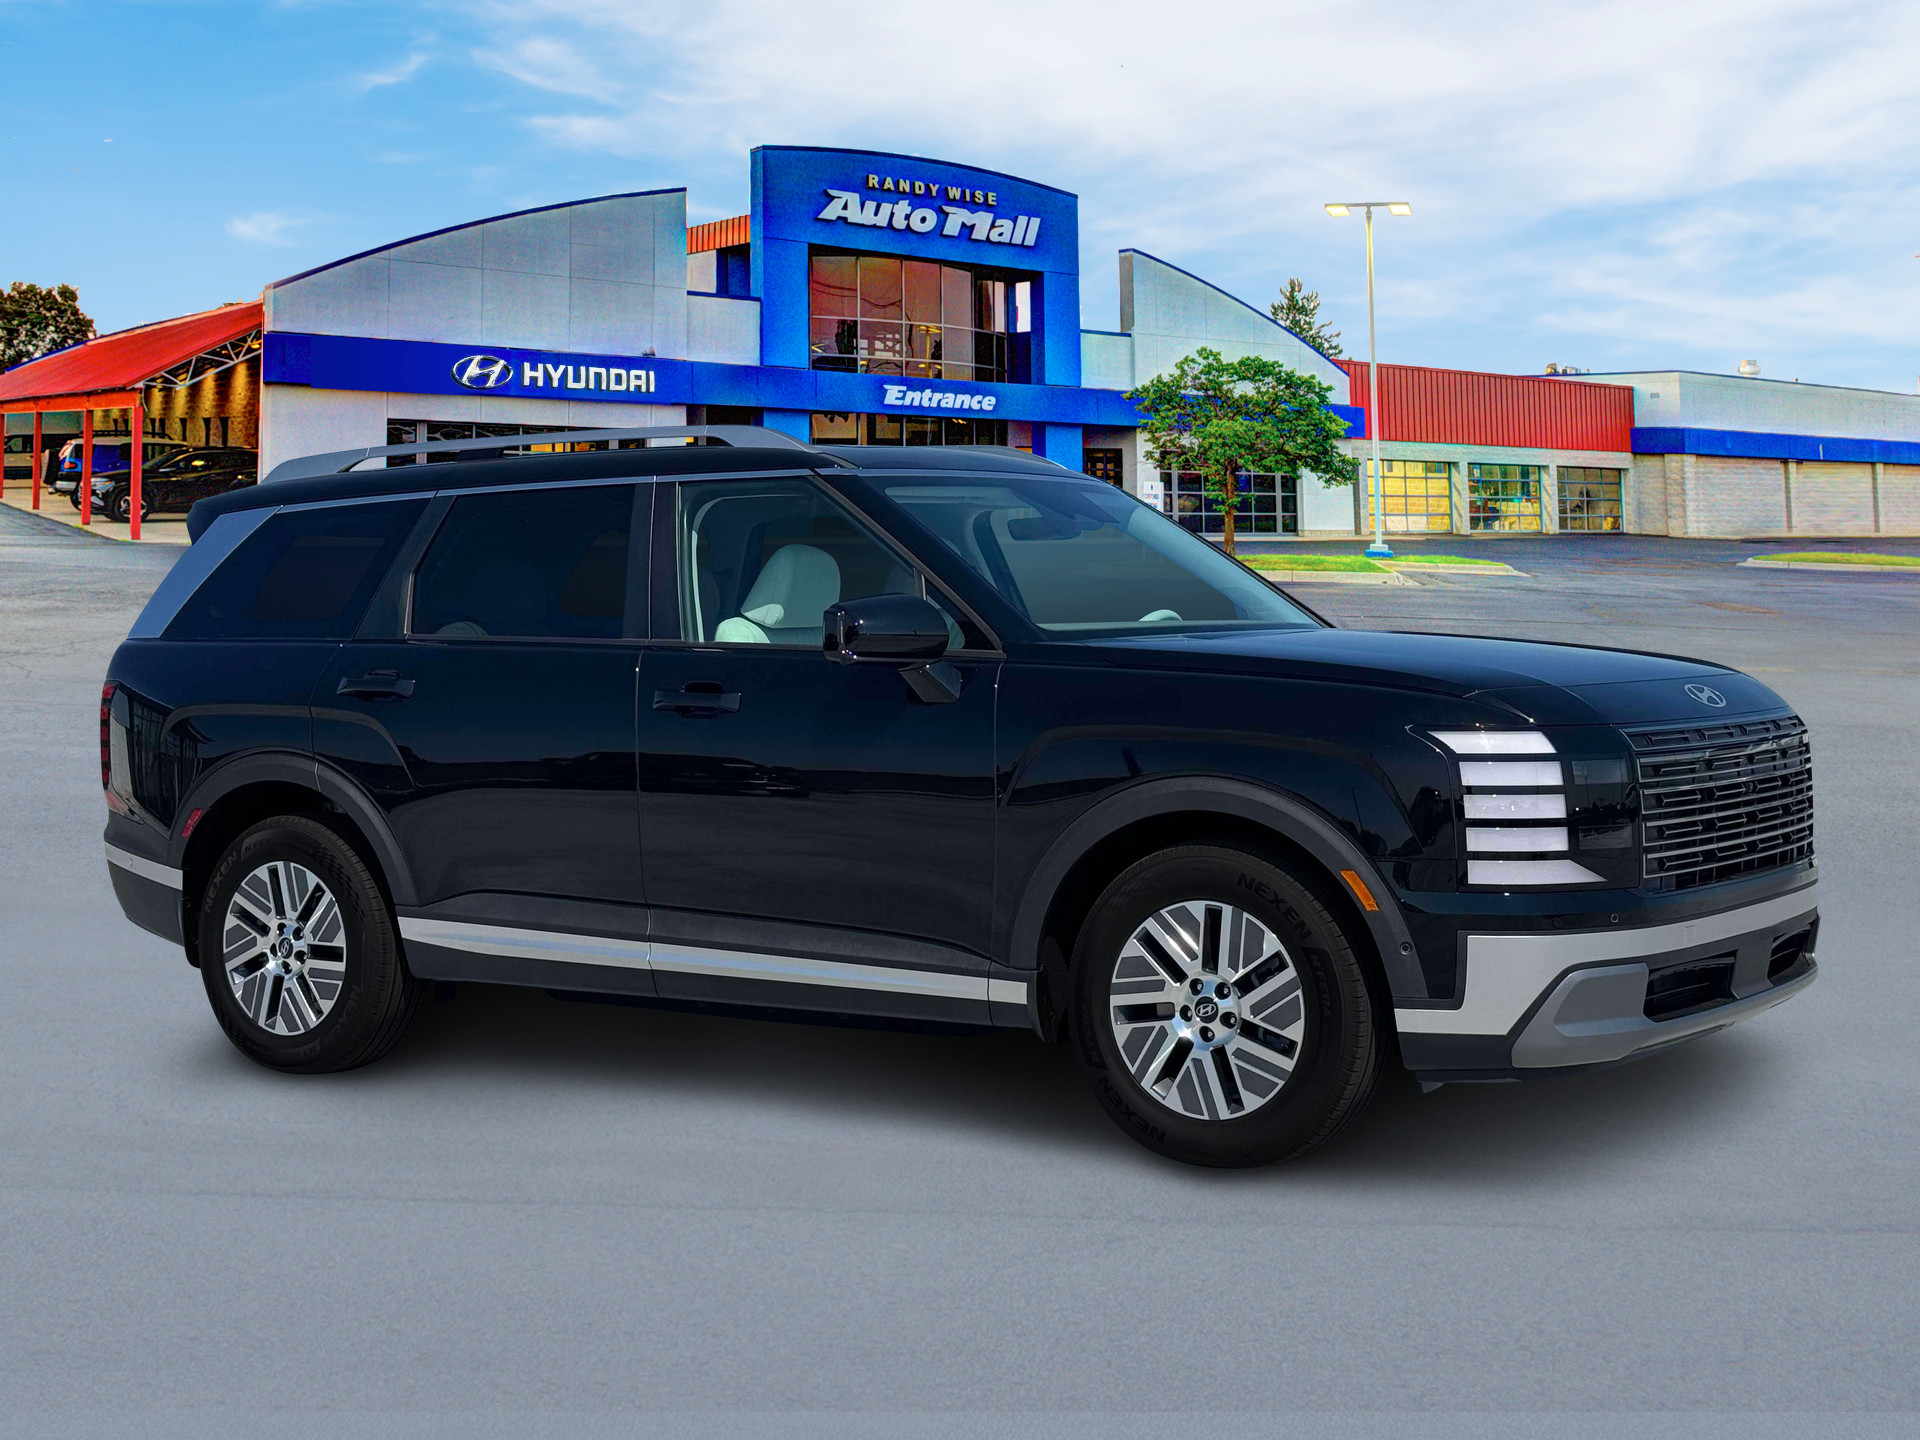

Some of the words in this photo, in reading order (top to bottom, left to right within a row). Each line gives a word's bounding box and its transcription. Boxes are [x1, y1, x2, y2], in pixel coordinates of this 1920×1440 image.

[817, 188, 937, 233] Auto
[941, 205, 1041, 247] Mall
[867, 174, 939, 197] RANDY
[947, 186, 997, 205] WISE
[522, 361, 656, 393] HYUNDAI
[883, 384, 997, 411] Entrance
[204, 850, 238, 914] NEXEN
[1236, 872, 1313, 942] NEXEN
[1100, 1075, 1167, 1145] NEXEN
